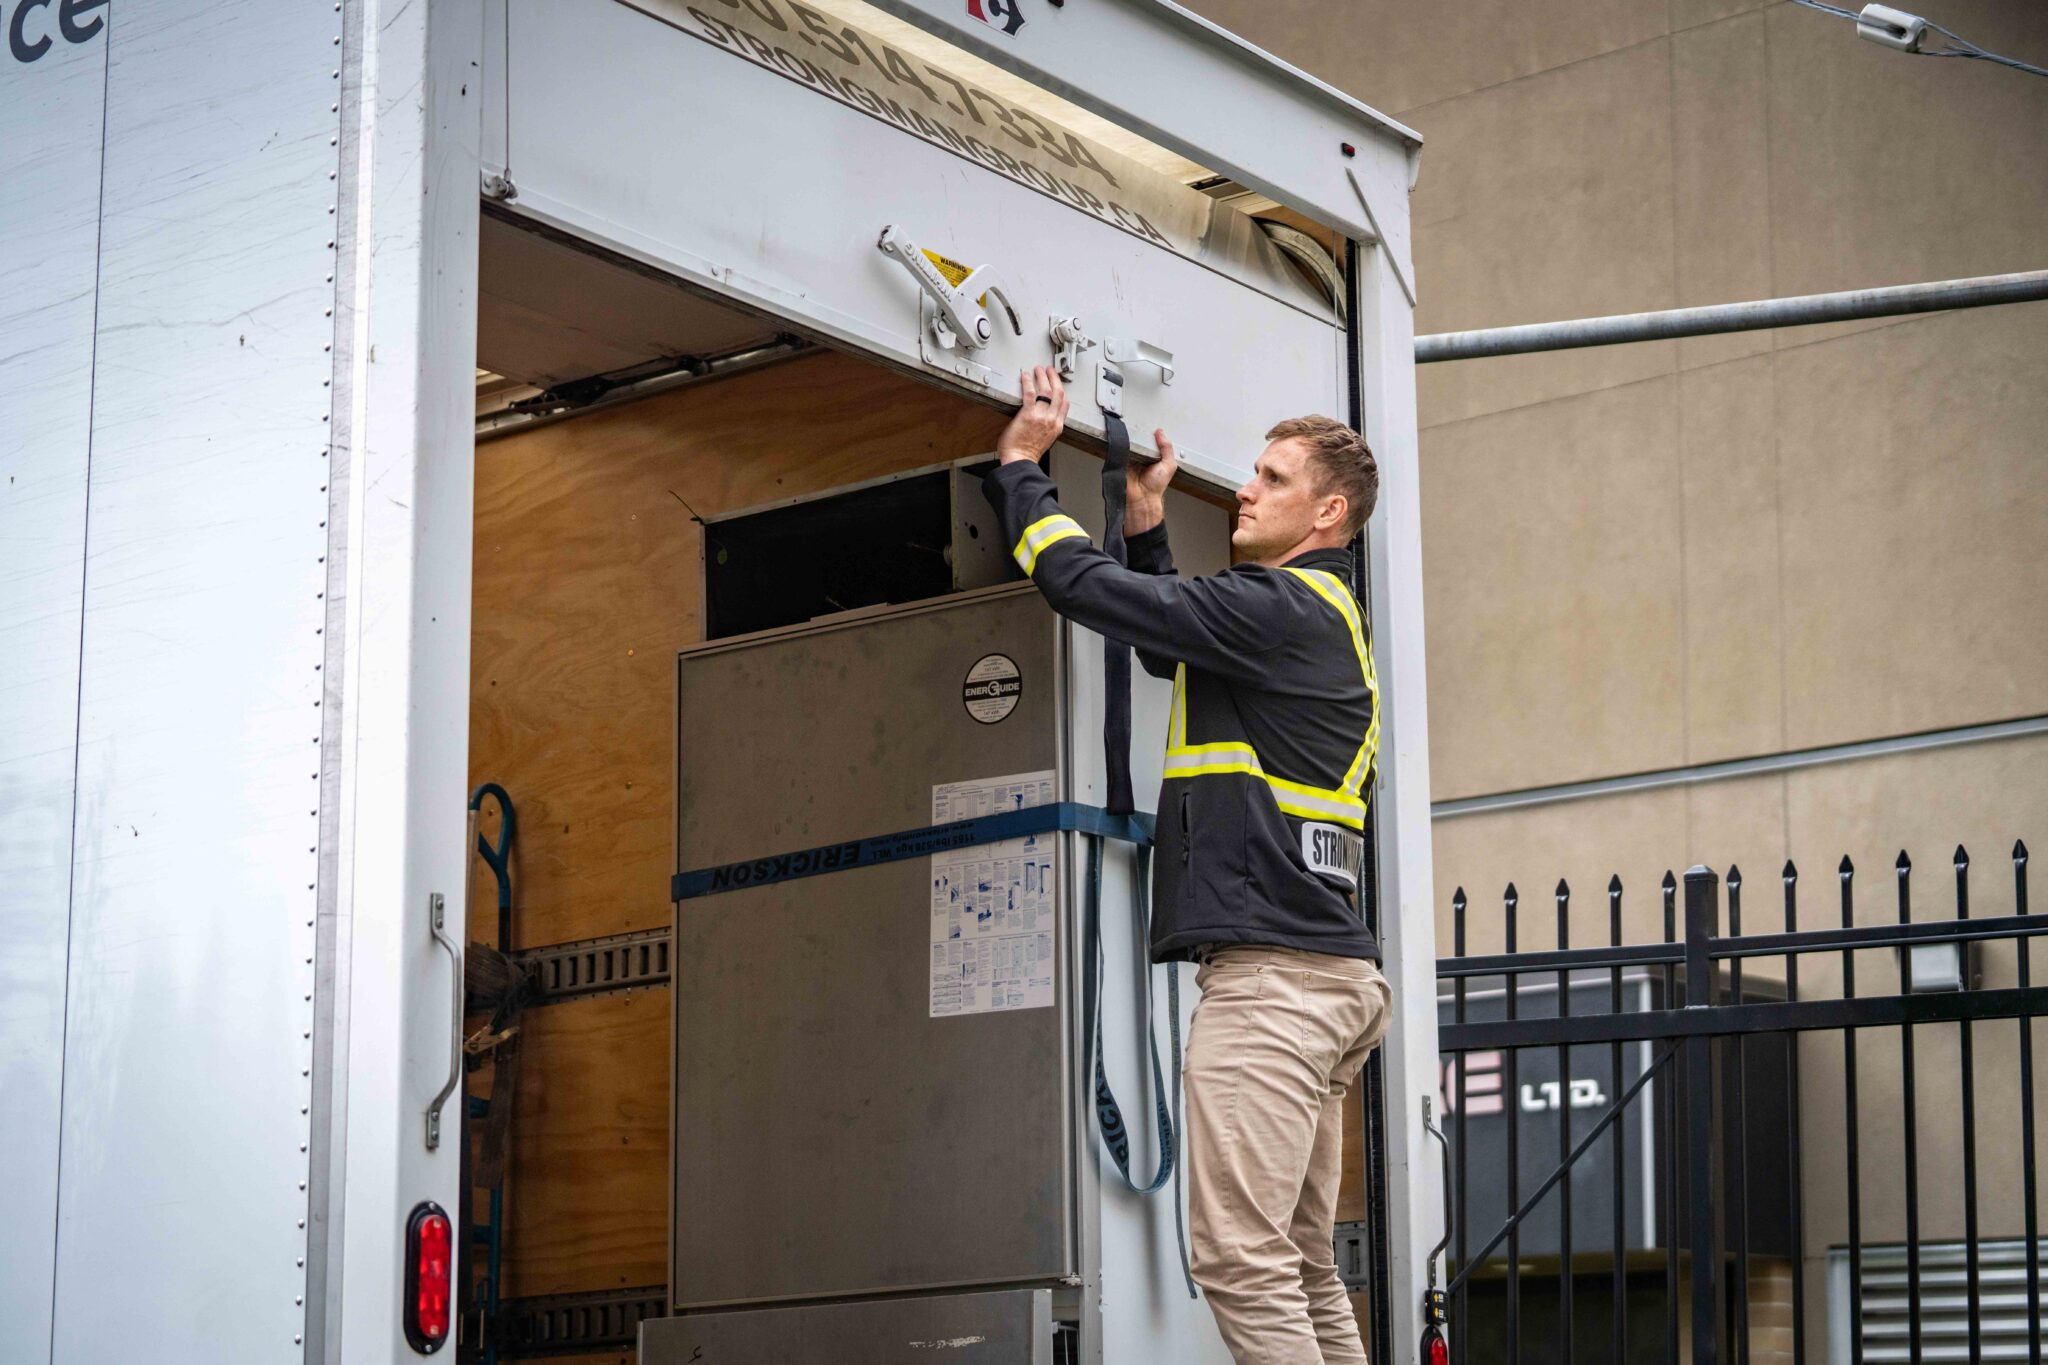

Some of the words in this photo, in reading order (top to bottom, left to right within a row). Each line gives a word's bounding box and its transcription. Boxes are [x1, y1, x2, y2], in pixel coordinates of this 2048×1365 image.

[0, 0, 105, 63] ce
[686, 5, 1176, 249] STRONGMANGROUP.CA
[965, 680, 1020, 697] ENERGUIDE
[711, 842, 863, 889] ERICKSON
[1439, 1052, 1503, 1116] E
[1520, 1078, 1607, 1112] LTD.
